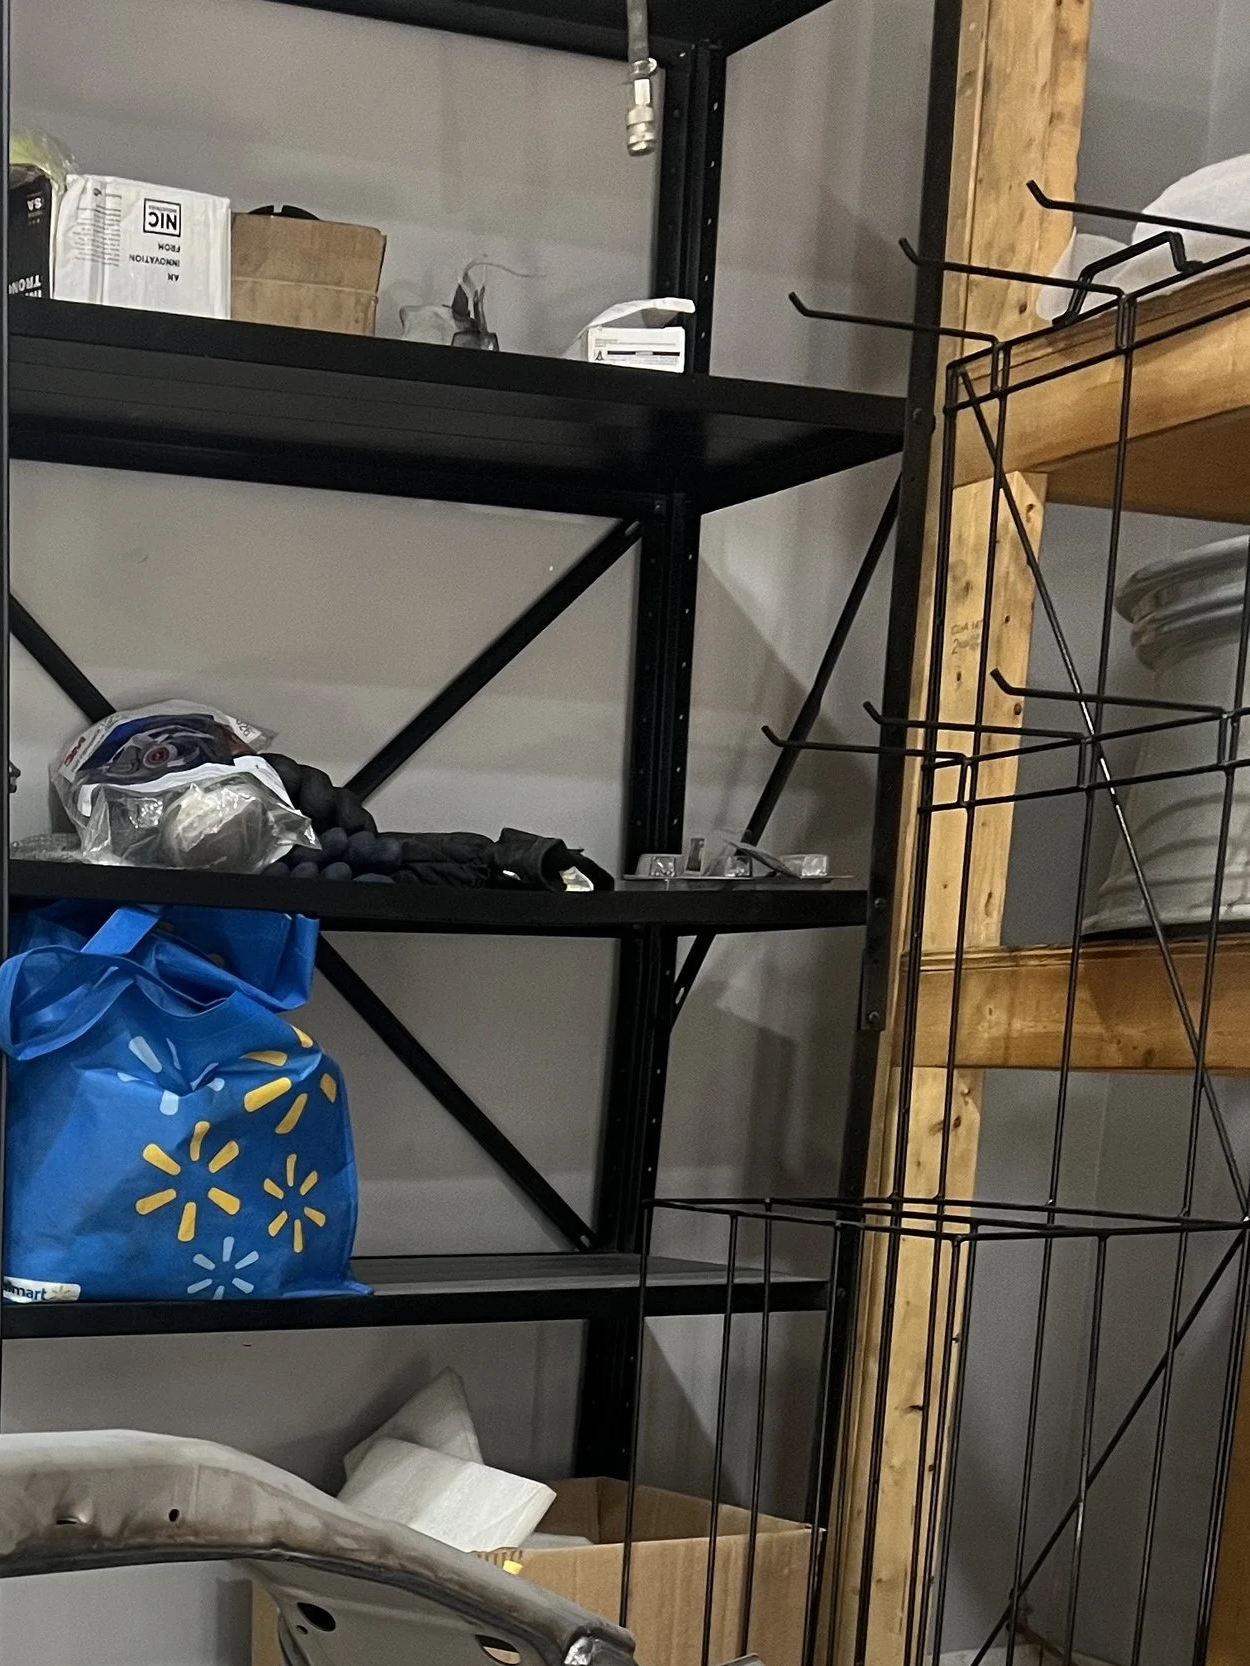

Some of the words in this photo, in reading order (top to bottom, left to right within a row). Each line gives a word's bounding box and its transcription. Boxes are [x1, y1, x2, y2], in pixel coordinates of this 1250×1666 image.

[148, 211, 177, 231] NIC
[158, 243, 180, 253] FROM
[129, 254, 180, 267] INNOVATION
[168, 273, 179, 281] AN
